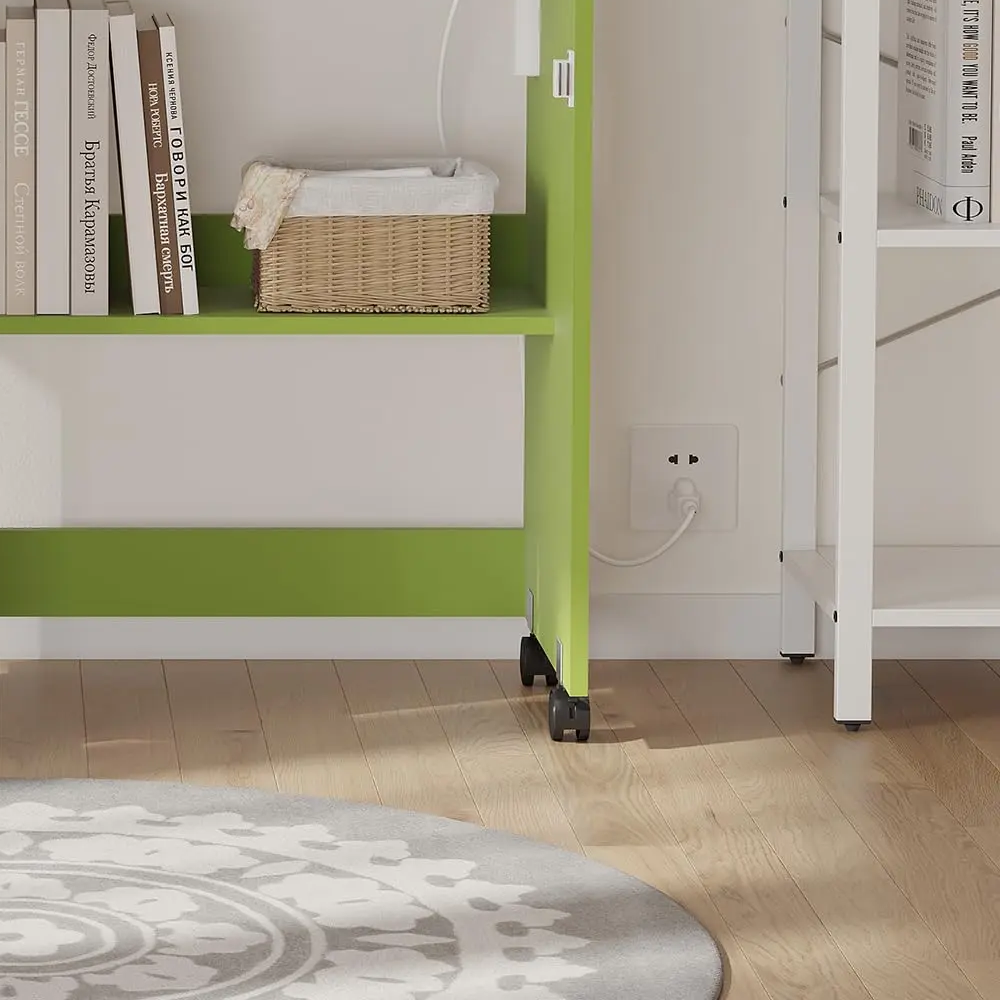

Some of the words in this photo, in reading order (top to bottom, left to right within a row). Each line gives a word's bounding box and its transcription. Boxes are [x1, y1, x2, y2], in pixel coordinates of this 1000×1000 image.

[963, 9, 979, 22] IT'S
[963, 24, 979, 41] HOW
[962, 42, 978, 61] GOOD
[15, 42, 26, 96] ГЕРМАН
[165, 52, 176, 85] КСЕНИЯ
[962, 63, 978, 77] YOU
[148, 82, 159, 107] НОРА
[167, 88, 179, 121] ЧЕРНОВА
[962, 80, 978, 99] WANT
[962, 101, 978, 111] TO
[962, 113, 978, 124] BE.
[14, 100, 30, 158] ГЕССЕ
[150, 108, 163, 148] РОБЕРТС
[961, 136, 978, 151] Paul
[79, 139, 101, 195] Братья
[169, 127, 188, 202] ГОВОРИ
[961, 153, 978, 174] Arden
[13, 182, 30, 256] Степной
[152, 172, 170, 245] Бархатная
[161, 247, 176, 294] смерть
[177, 208, 191, 238] КАК
[79, 198, 101, 294] Карамазовы
[180, 244, 194, 272] БОГ
[14, 260, 27, 297] волк
